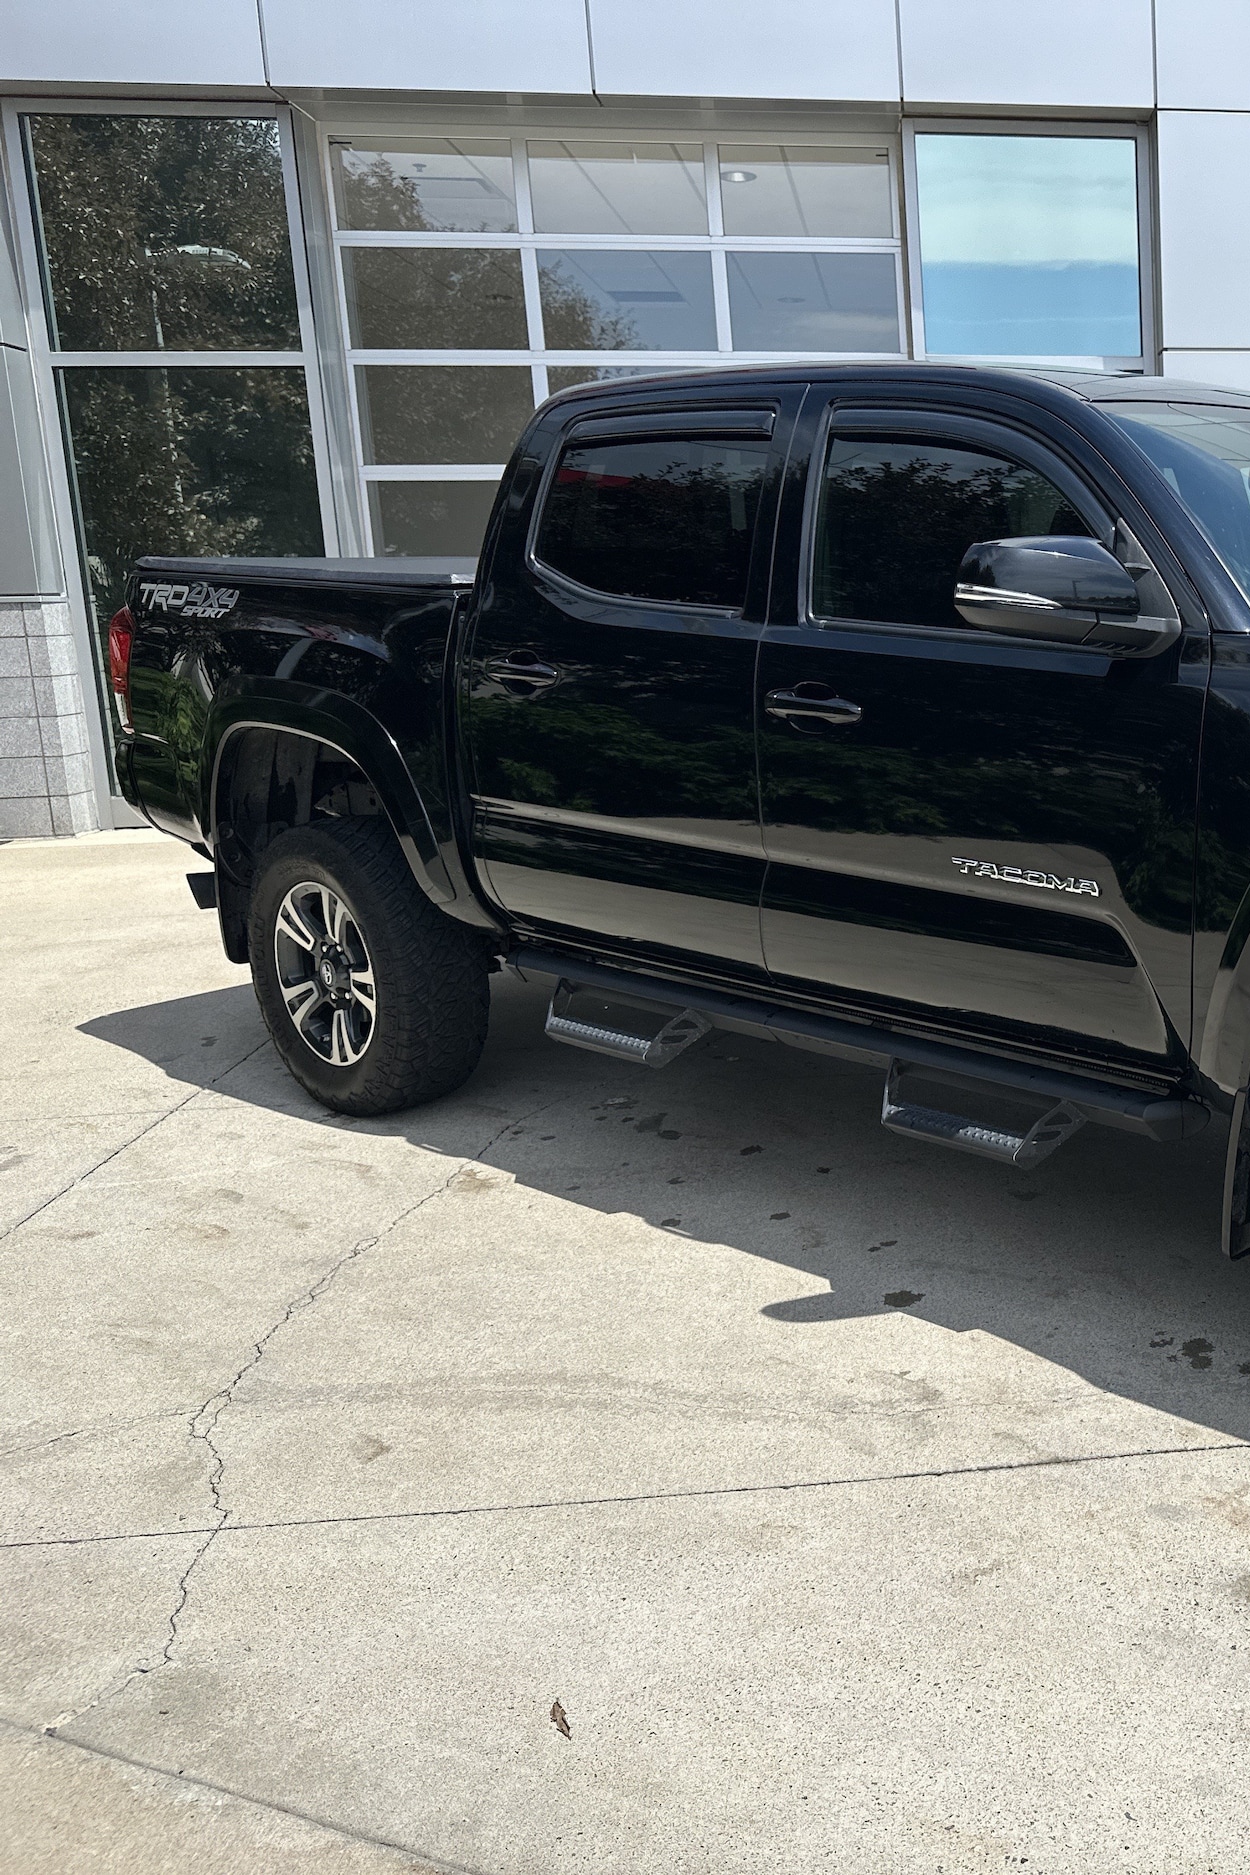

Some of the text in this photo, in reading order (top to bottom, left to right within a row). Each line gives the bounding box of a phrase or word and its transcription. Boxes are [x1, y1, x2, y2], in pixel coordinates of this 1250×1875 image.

[140, 583, 189, 611] TRD
[180, 605, 230, 619] SPORT
[951, 856, 1100, 898] TACOMA
